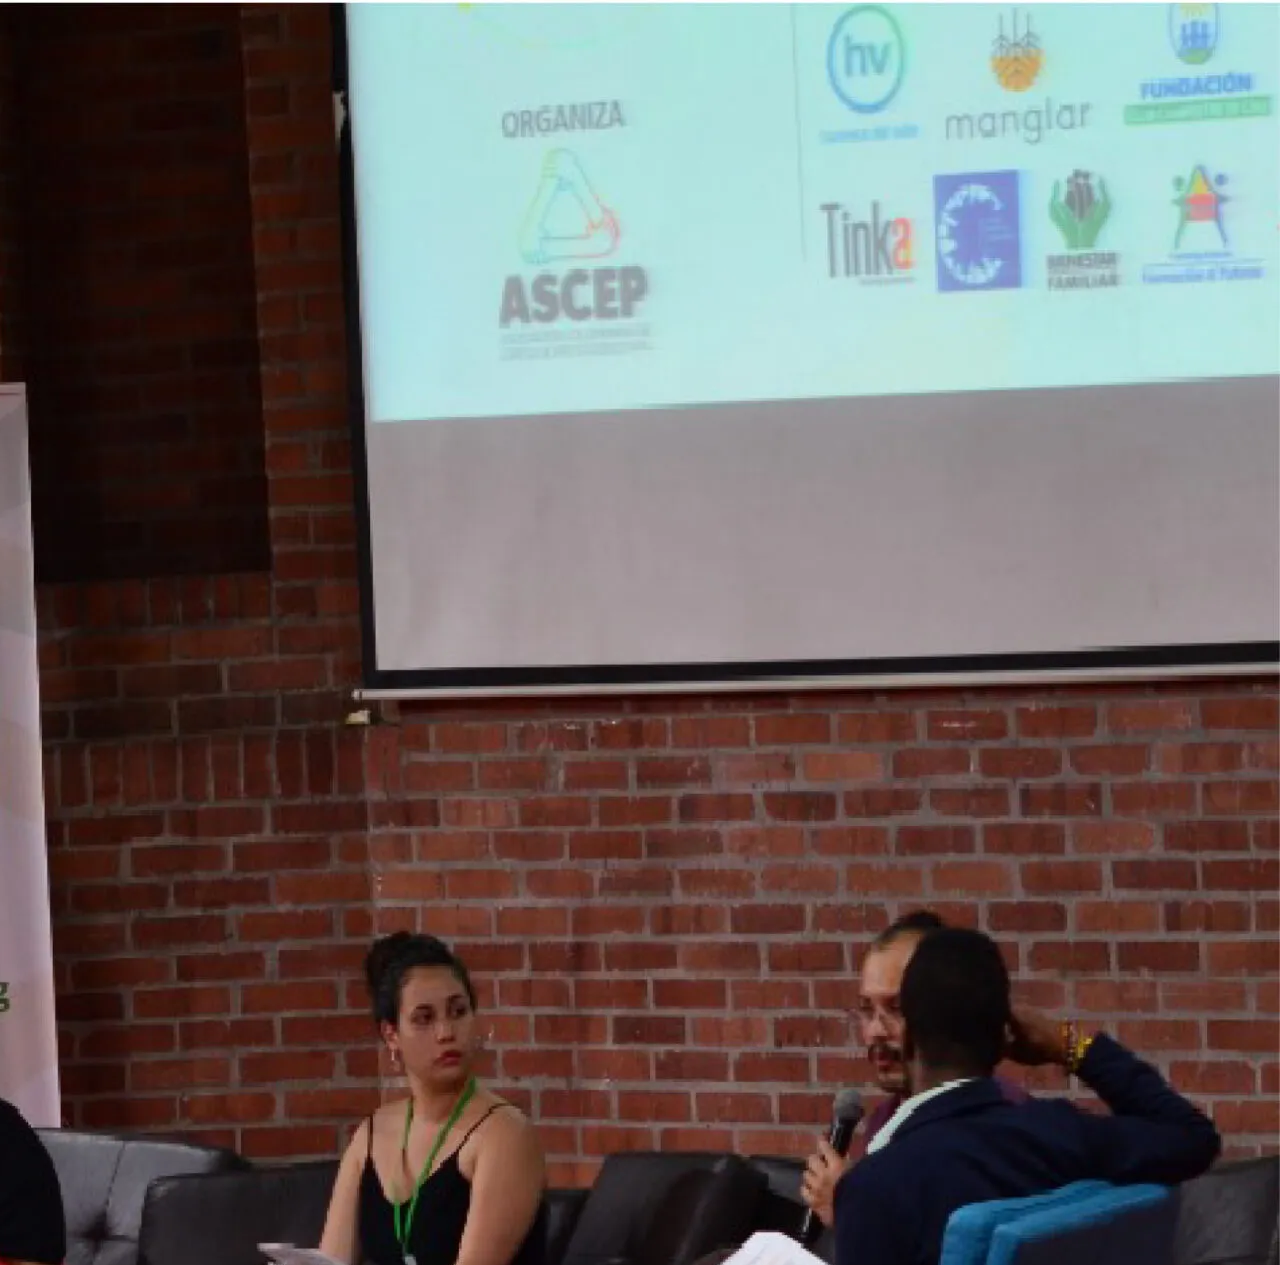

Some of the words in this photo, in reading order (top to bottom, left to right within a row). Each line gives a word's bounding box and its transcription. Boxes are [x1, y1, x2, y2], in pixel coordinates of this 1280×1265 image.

[843, 35, 890, 77] hv
[501, 100, 625, 138] ORGANIZA
[945, 96, 1091, 145] manglar
[819, 201, 913, 278] Tinka
[499, 265, 648, 328] ASCEP
[1047, 274, 1119, 290] FAMILIAR
